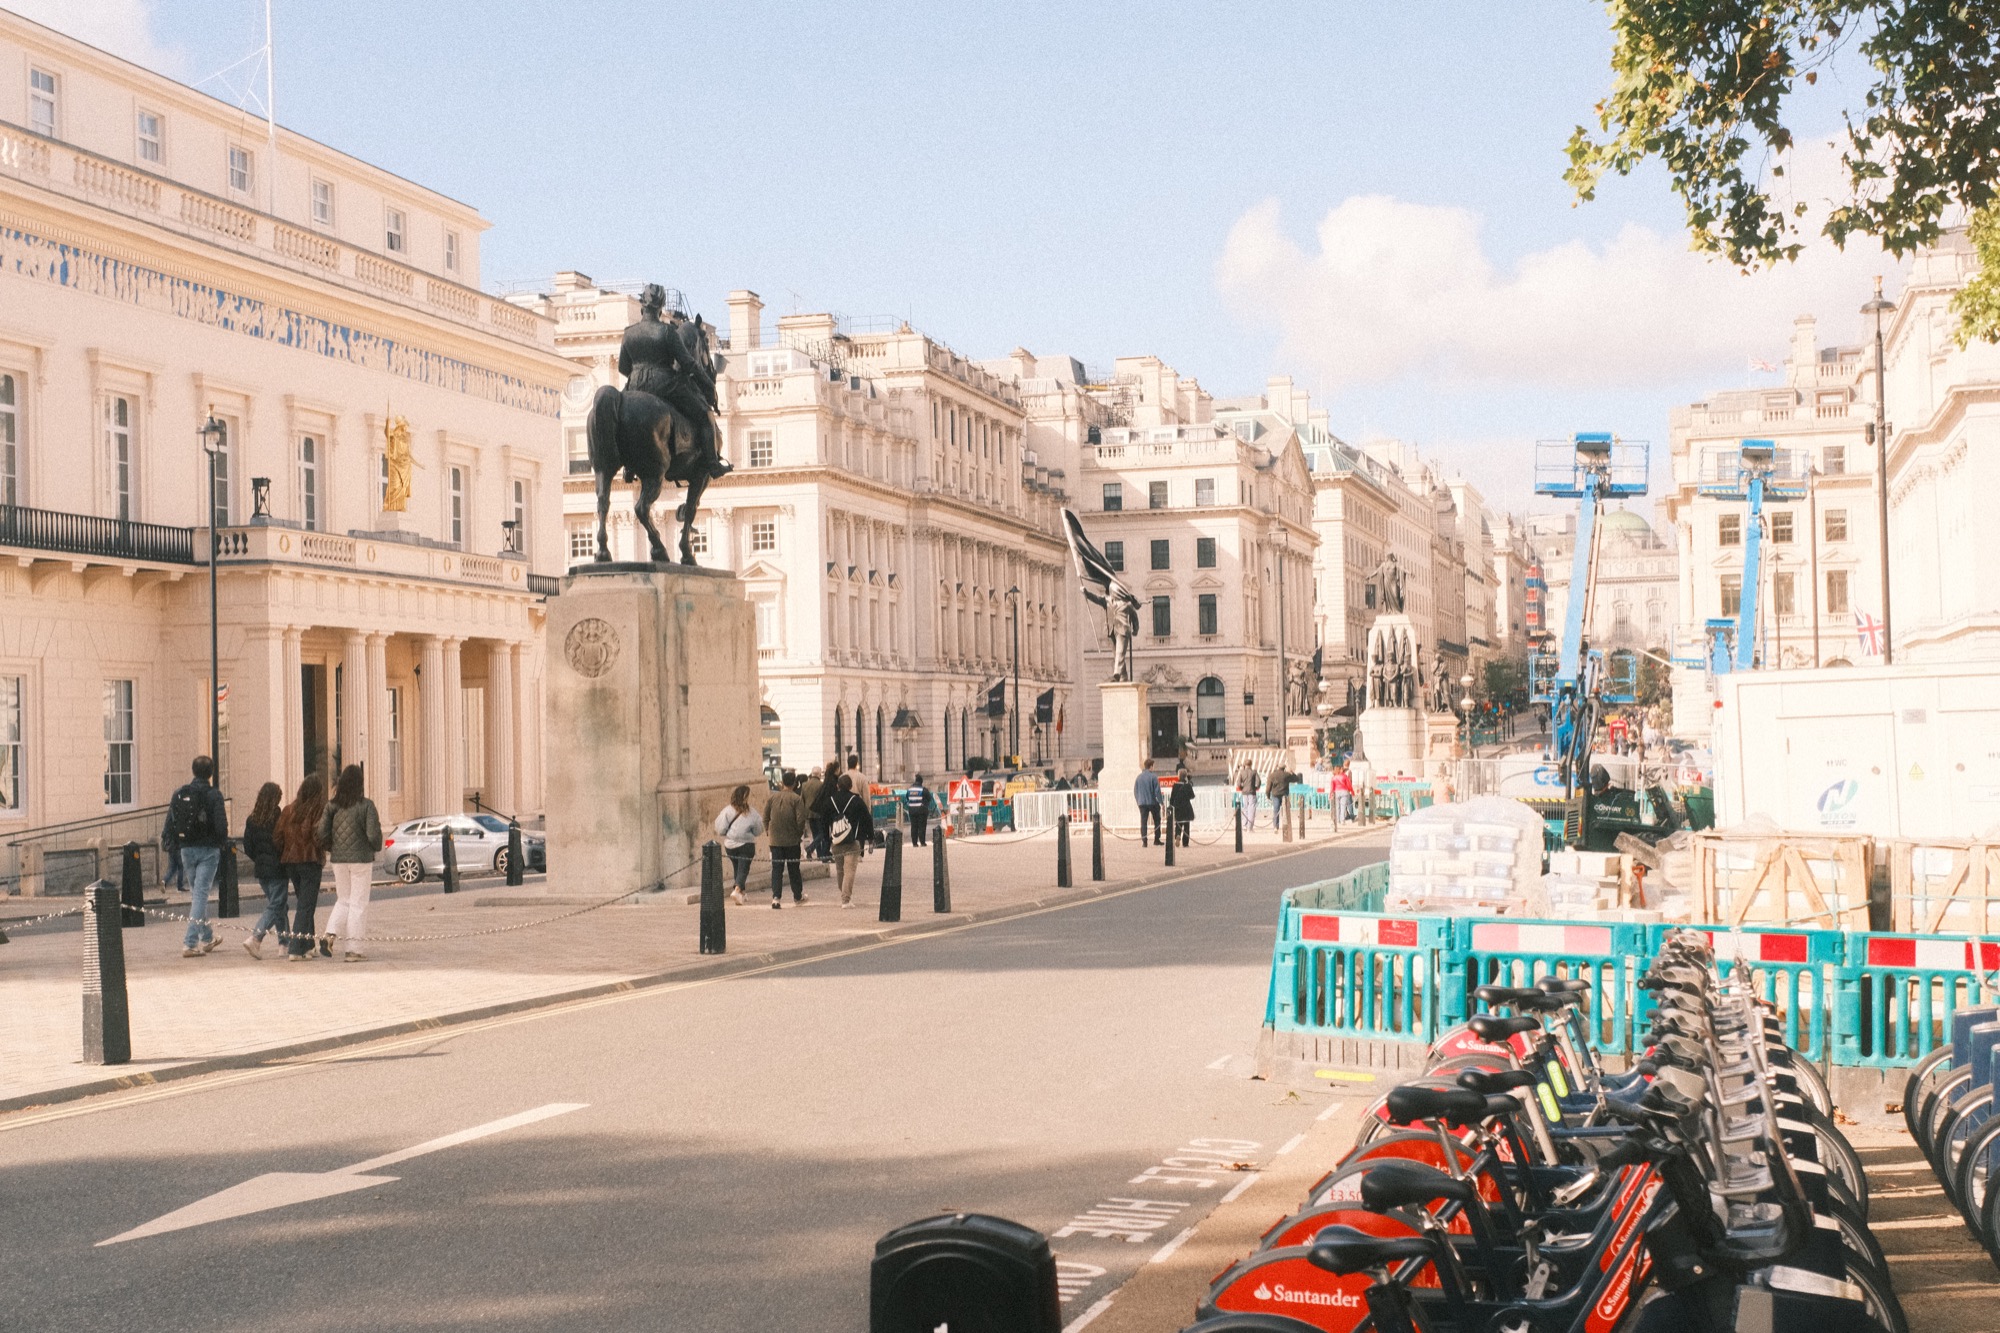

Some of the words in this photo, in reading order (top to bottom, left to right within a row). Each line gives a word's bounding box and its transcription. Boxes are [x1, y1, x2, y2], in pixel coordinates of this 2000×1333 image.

[1834, 759, 1848, 767] WC
[1820, 812, 1857, 820] NIXON
[1127, 1138, 1263, 1188] CYCLE
[1052, 1197, 1191, 1243] HIRE
[1274, 1283, 1361, 1308] Santander
